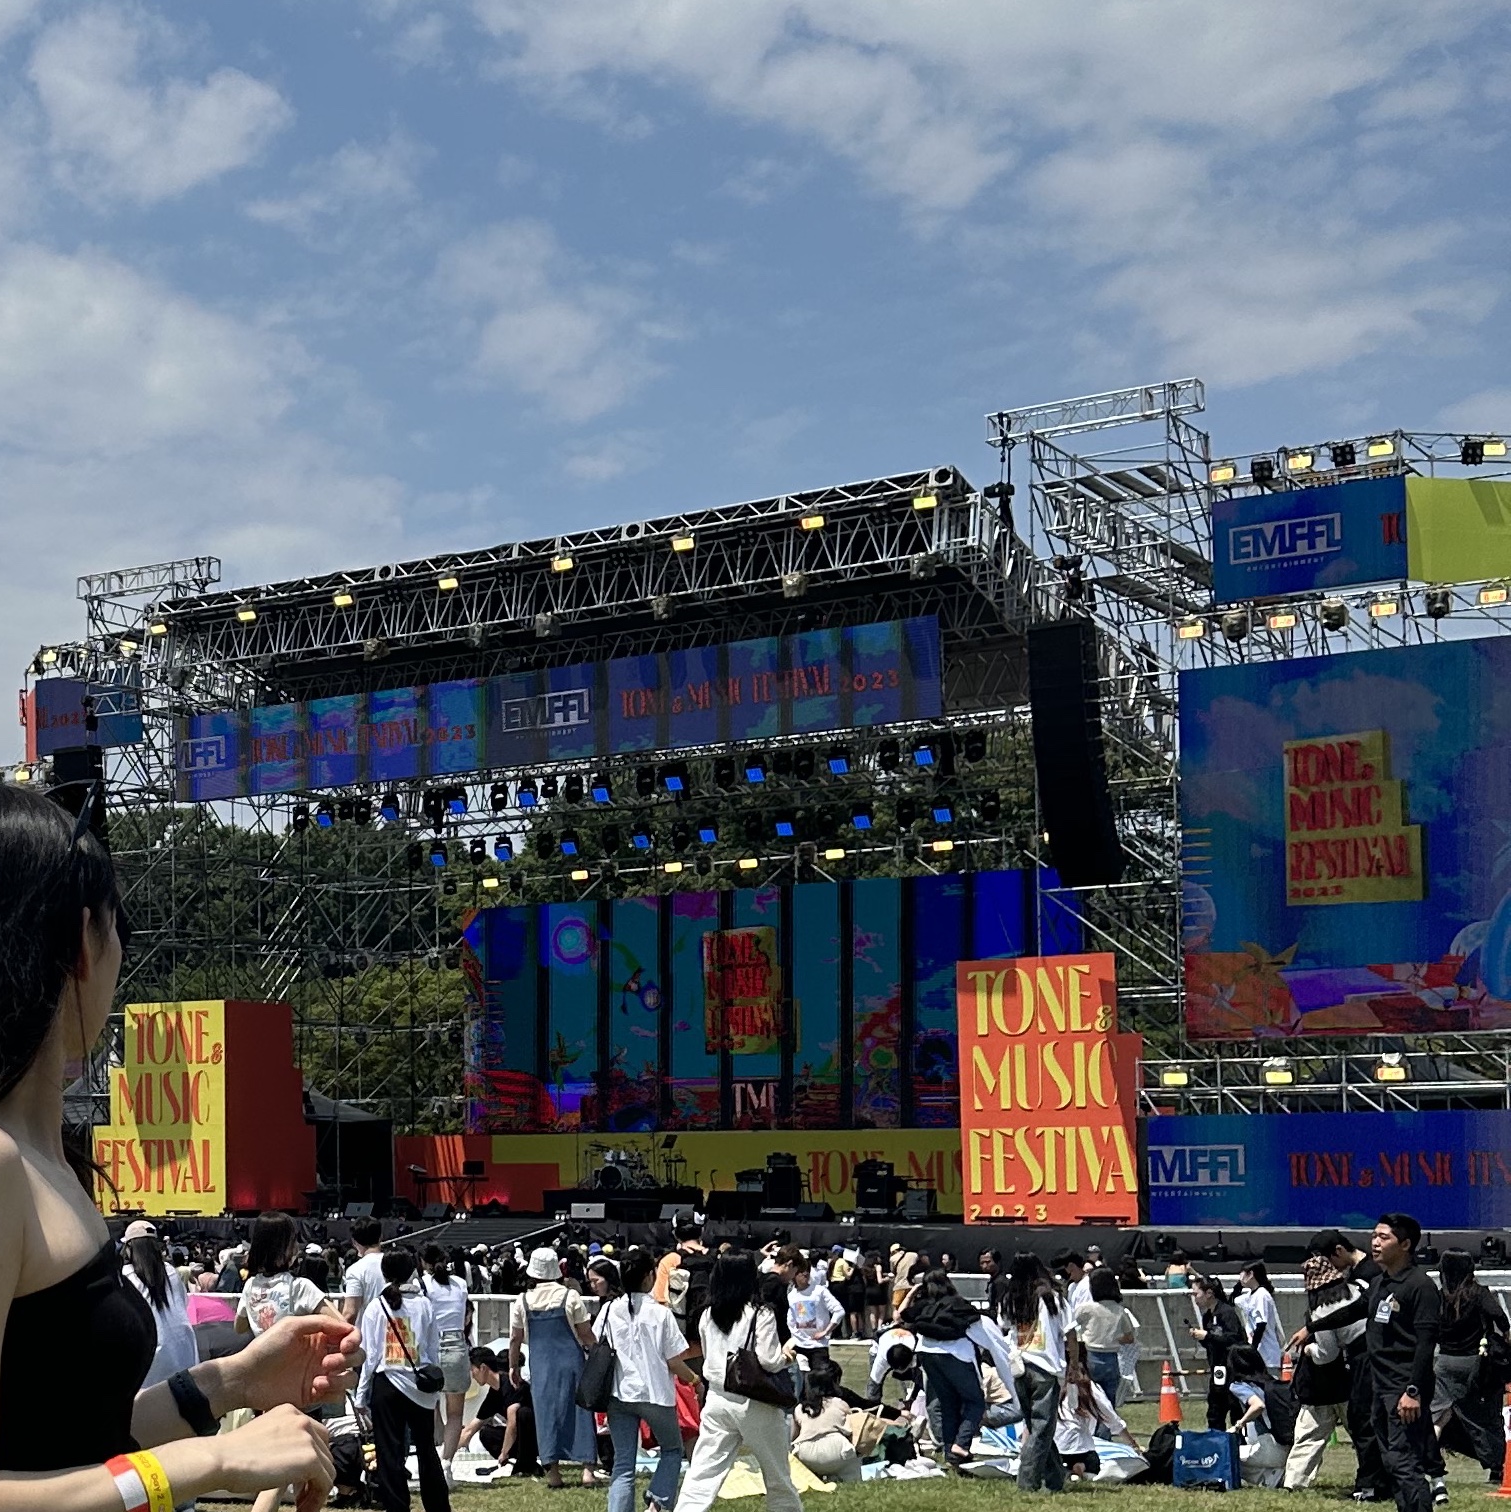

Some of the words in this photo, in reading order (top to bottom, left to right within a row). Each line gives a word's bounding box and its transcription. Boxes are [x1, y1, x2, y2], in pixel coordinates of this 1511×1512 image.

[1290, 785, 1382, 832] MUSIC
[118, 1070, 210, 1126] MUSIC
[972, 1039, 1118, 1111] MUSIC
[97, 1138, 215, 1194] FESTIVAL
[969, 1204, 1048, 1221] 2023
